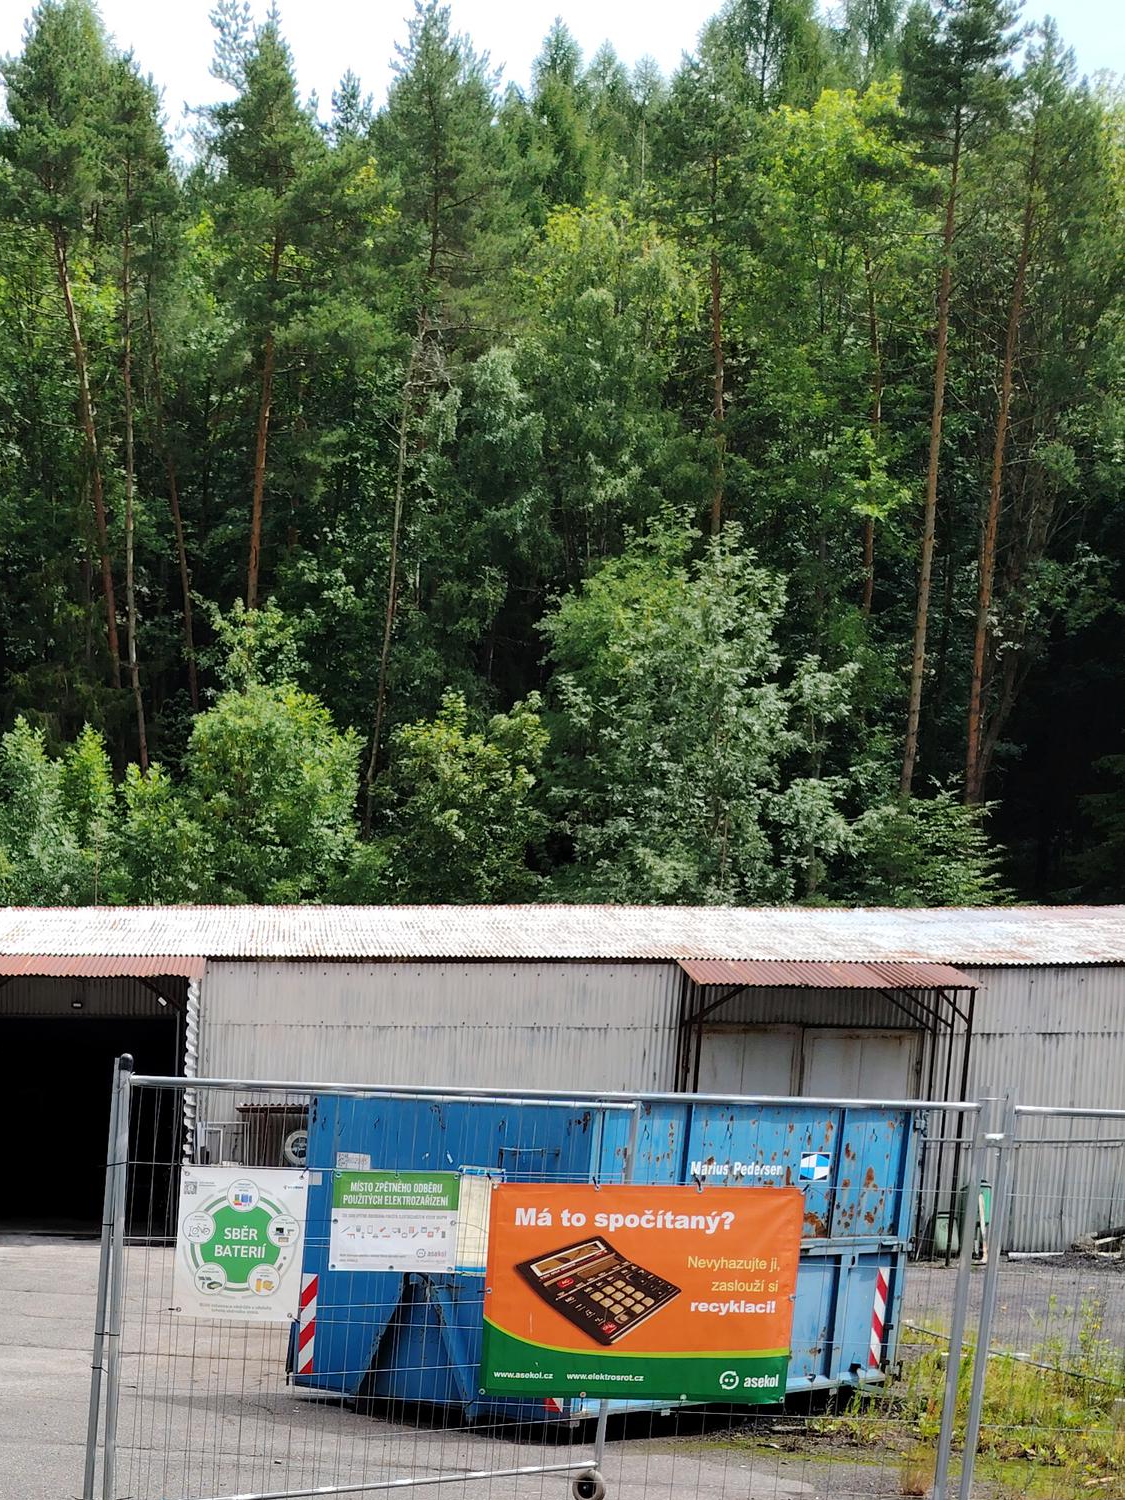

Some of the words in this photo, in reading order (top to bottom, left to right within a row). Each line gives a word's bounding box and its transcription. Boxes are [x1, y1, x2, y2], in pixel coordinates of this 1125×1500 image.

[690, 1161, 729, 1175] Marius
[733, 1161, 783, 1176] Pedersen
[350, 1181, 373, 1193] MÍSTO
[375, 1180, 411, 1193] ZPĚTNÉHO
[413, 1182, 443, 1194] ODBĚRU
[343, 1194, 383, 1205] POUŽITÝCH
[384, 1195, 449, 1207] ELEKTROZAŘÍZENÍ
[515, 1207, 552, 1226] Má
[560, 1208, 586, 1227] to
[594, 1209, 736, 1234] spočítaný?
[224, 1225, 258, 1240] SBĚR
[214, 1243, 267, 1259] BATERIÍ
[687, 1255, 767, 1272] Nevyhazujte
[769, 1257, 780, 1272] ji,
[711, 1280, 764, 1292] zaslouží
[768, 1280, 779, 1292] si
[690, 1300, 776, 1316] recyklaci!
[493, 1370, 554, 1380] www.asekol.cz
[566, 1371, 645, 1382] www.elektrosrot.cz
[743, 1374, 780, 1388] asekol
